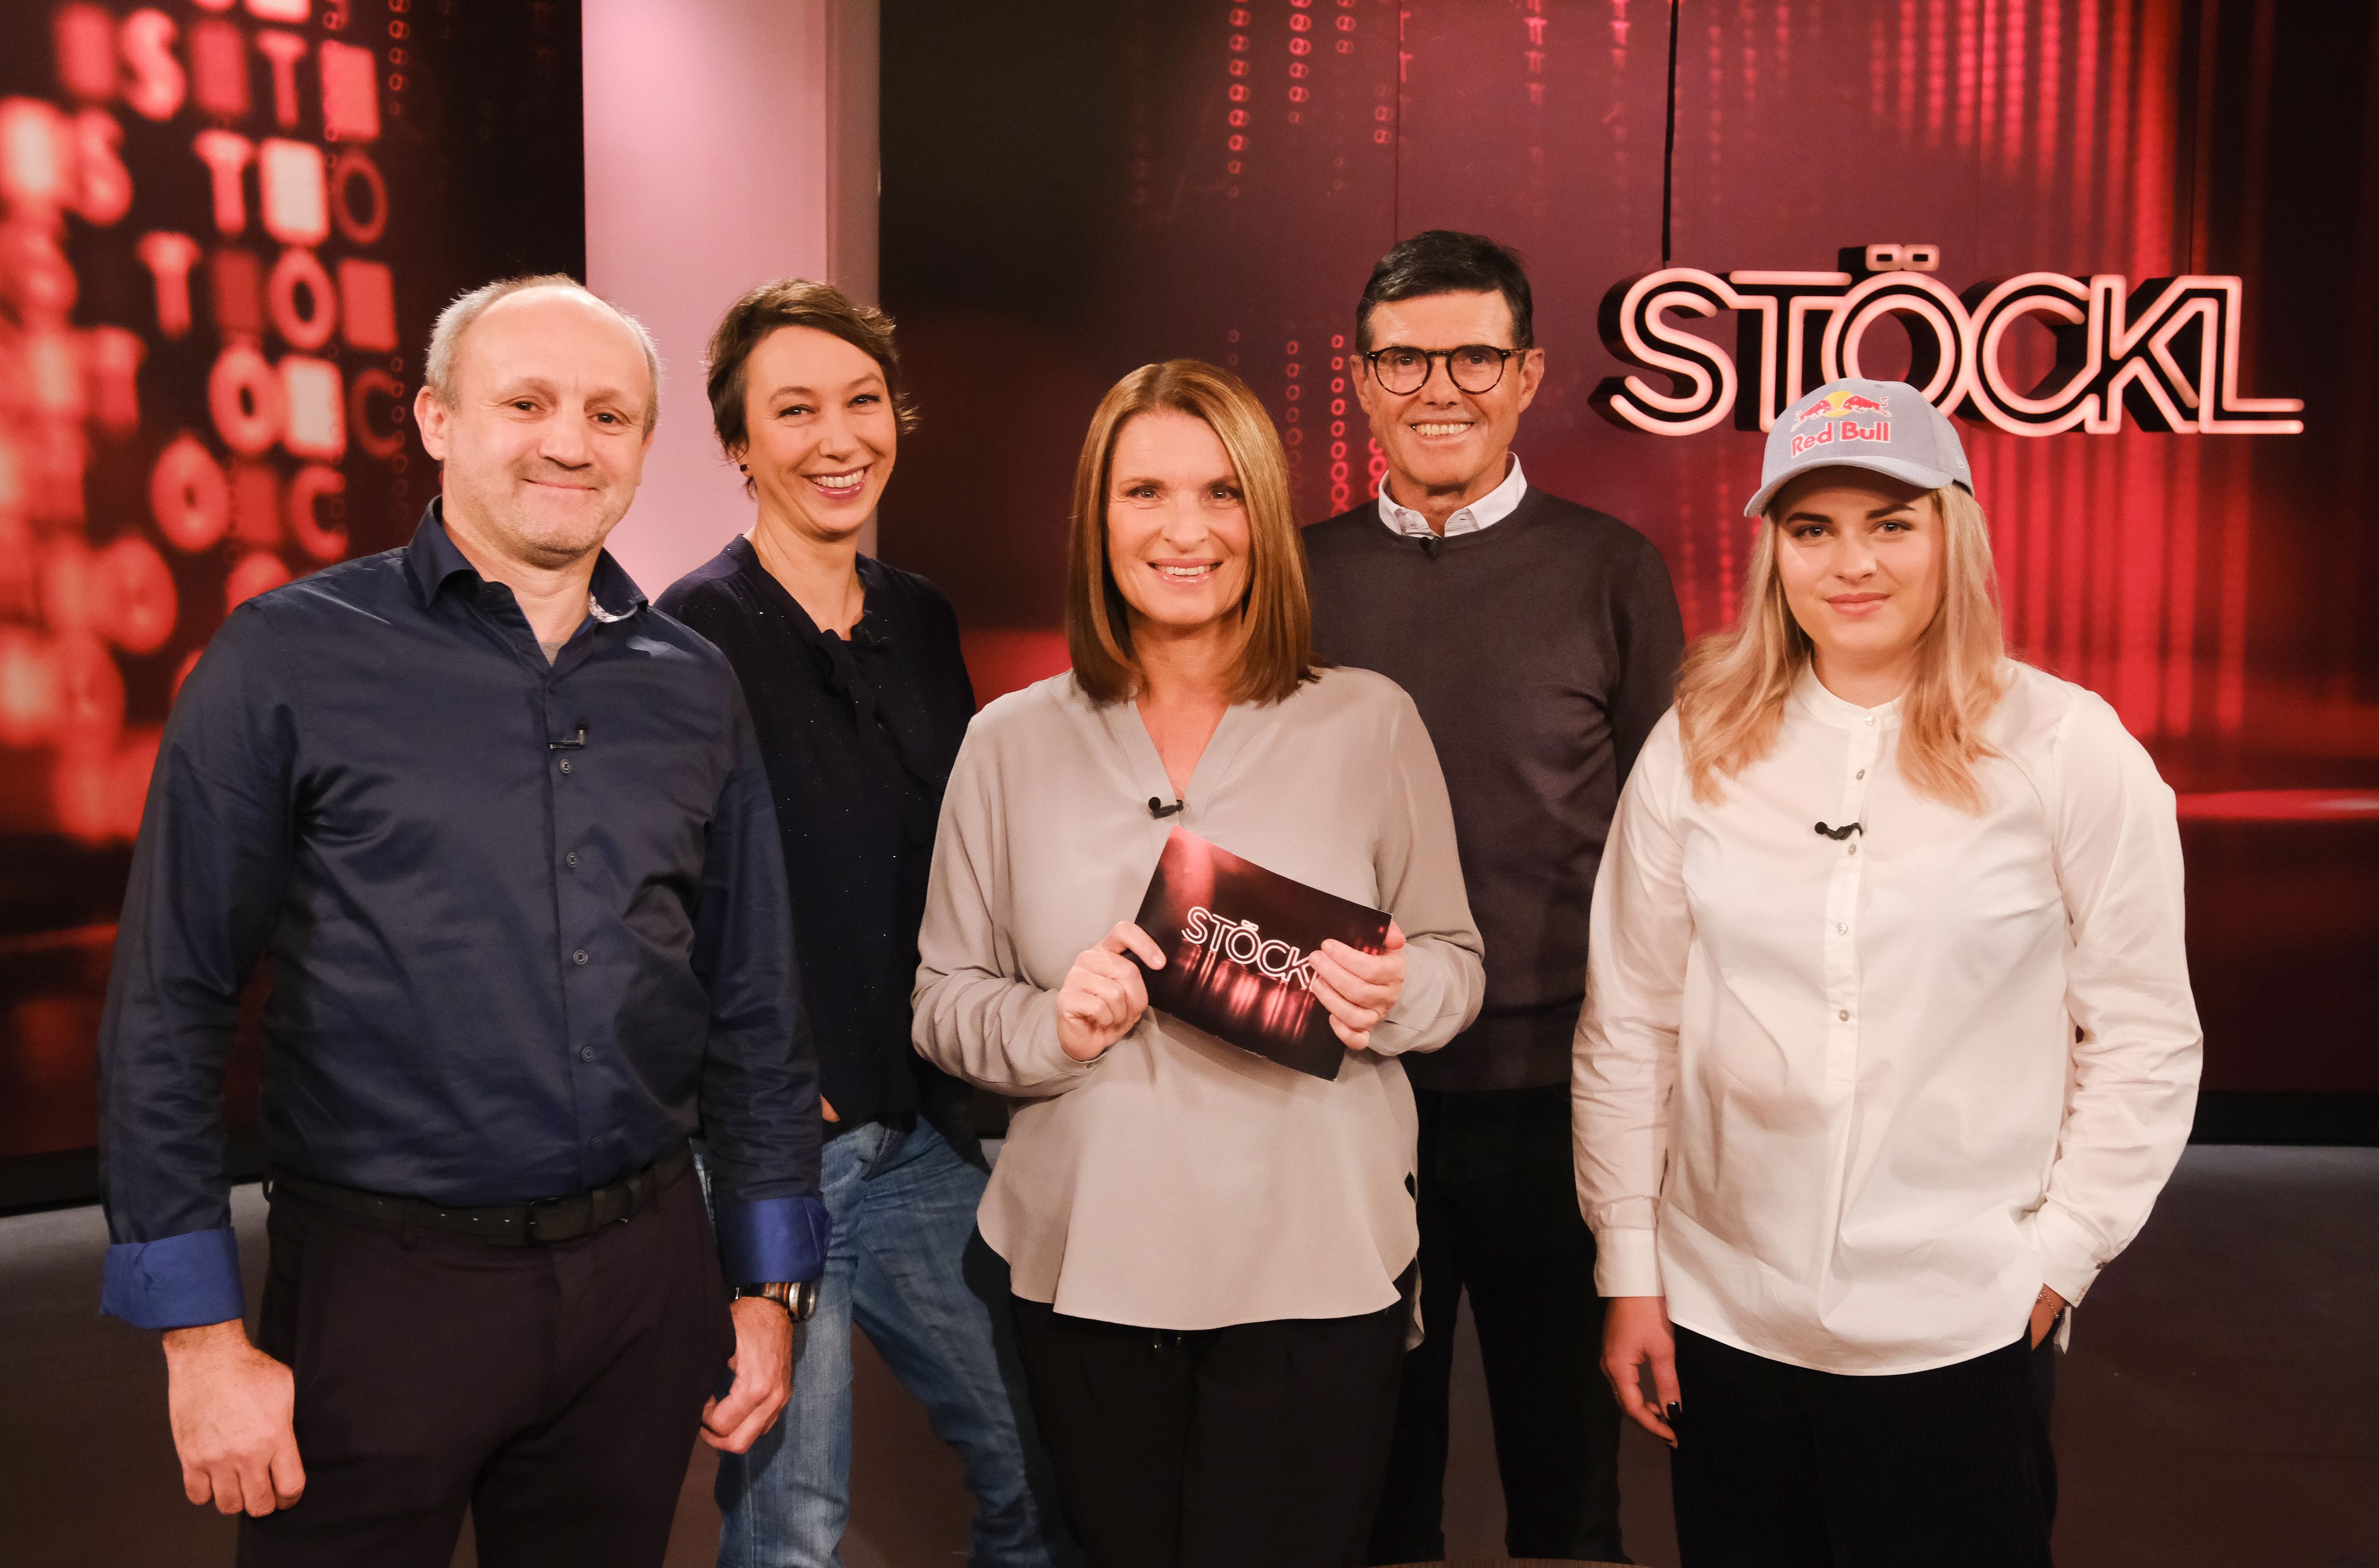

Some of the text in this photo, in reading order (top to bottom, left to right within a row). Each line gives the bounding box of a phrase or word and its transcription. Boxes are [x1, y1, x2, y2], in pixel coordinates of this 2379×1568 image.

[1609, 244, 2305, 436] STÖCKL
[1791, 421, 1891, 458] Red Bull
[1181, 906, 1317, 991] STÖCK
